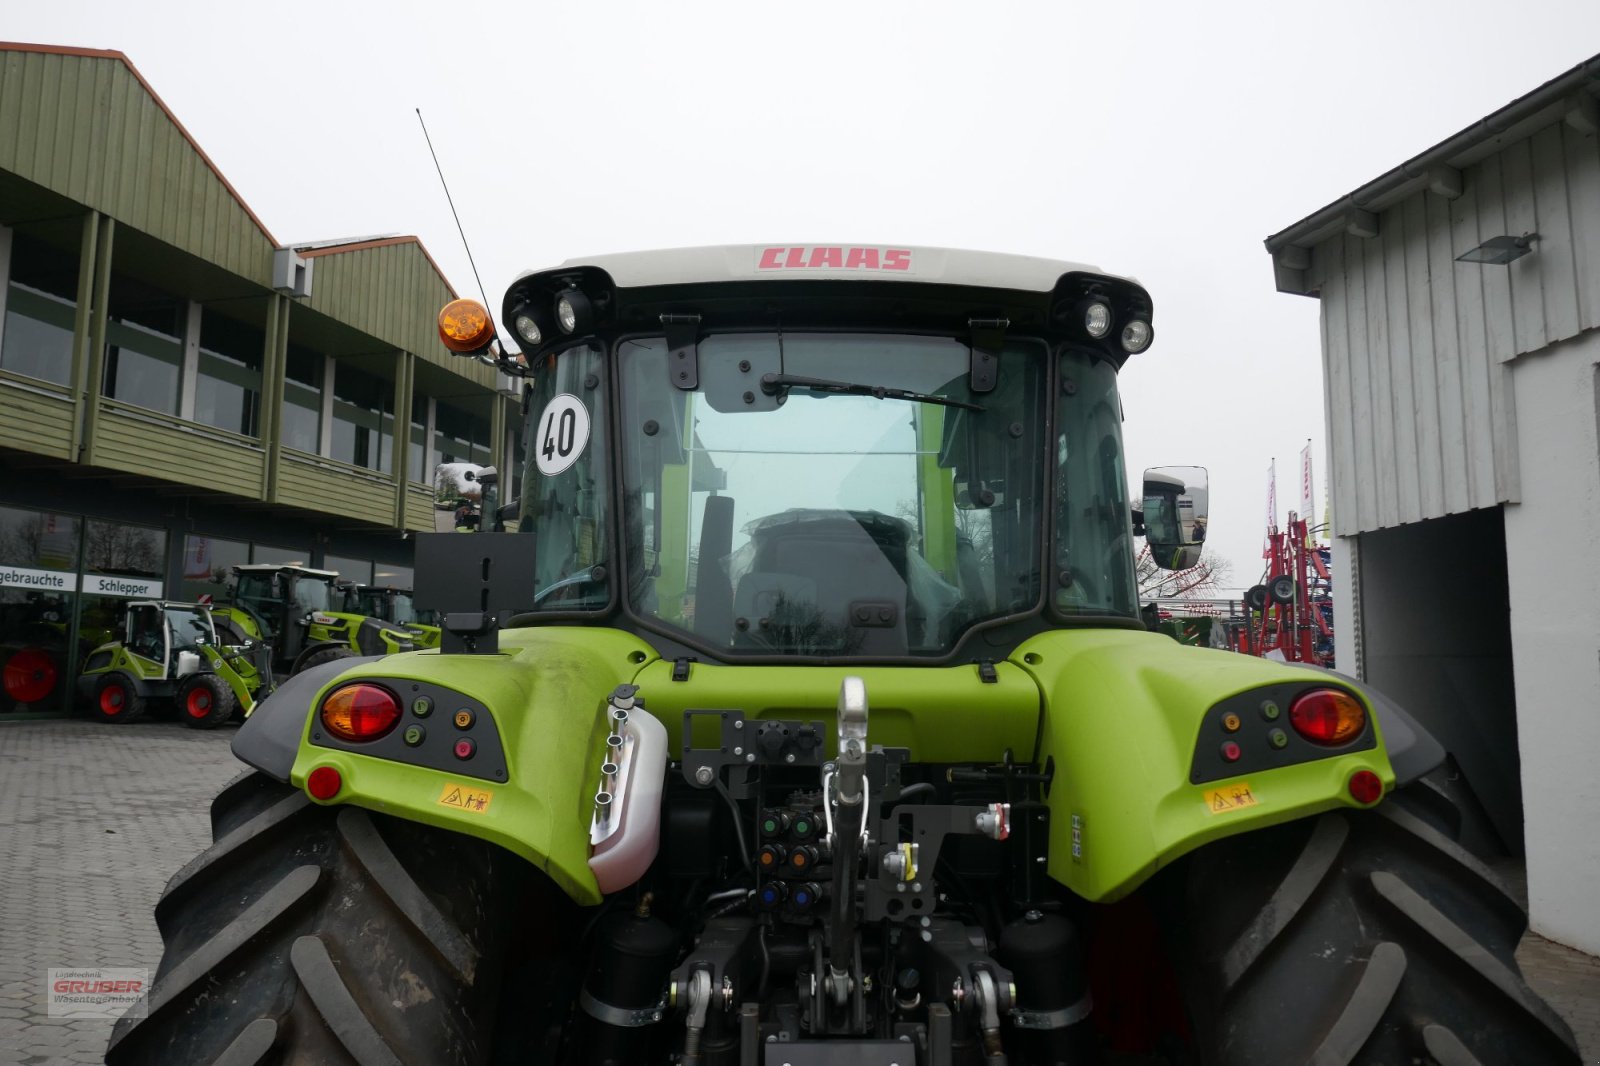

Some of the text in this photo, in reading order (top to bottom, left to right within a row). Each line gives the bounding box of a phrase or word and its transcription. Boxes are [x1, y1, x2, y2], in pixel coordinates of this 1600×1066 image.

[758, 247, 911, 271] CLAAS
[542, 408, 576, 461] 40
[99, 579, 149, 596] Schlepper
